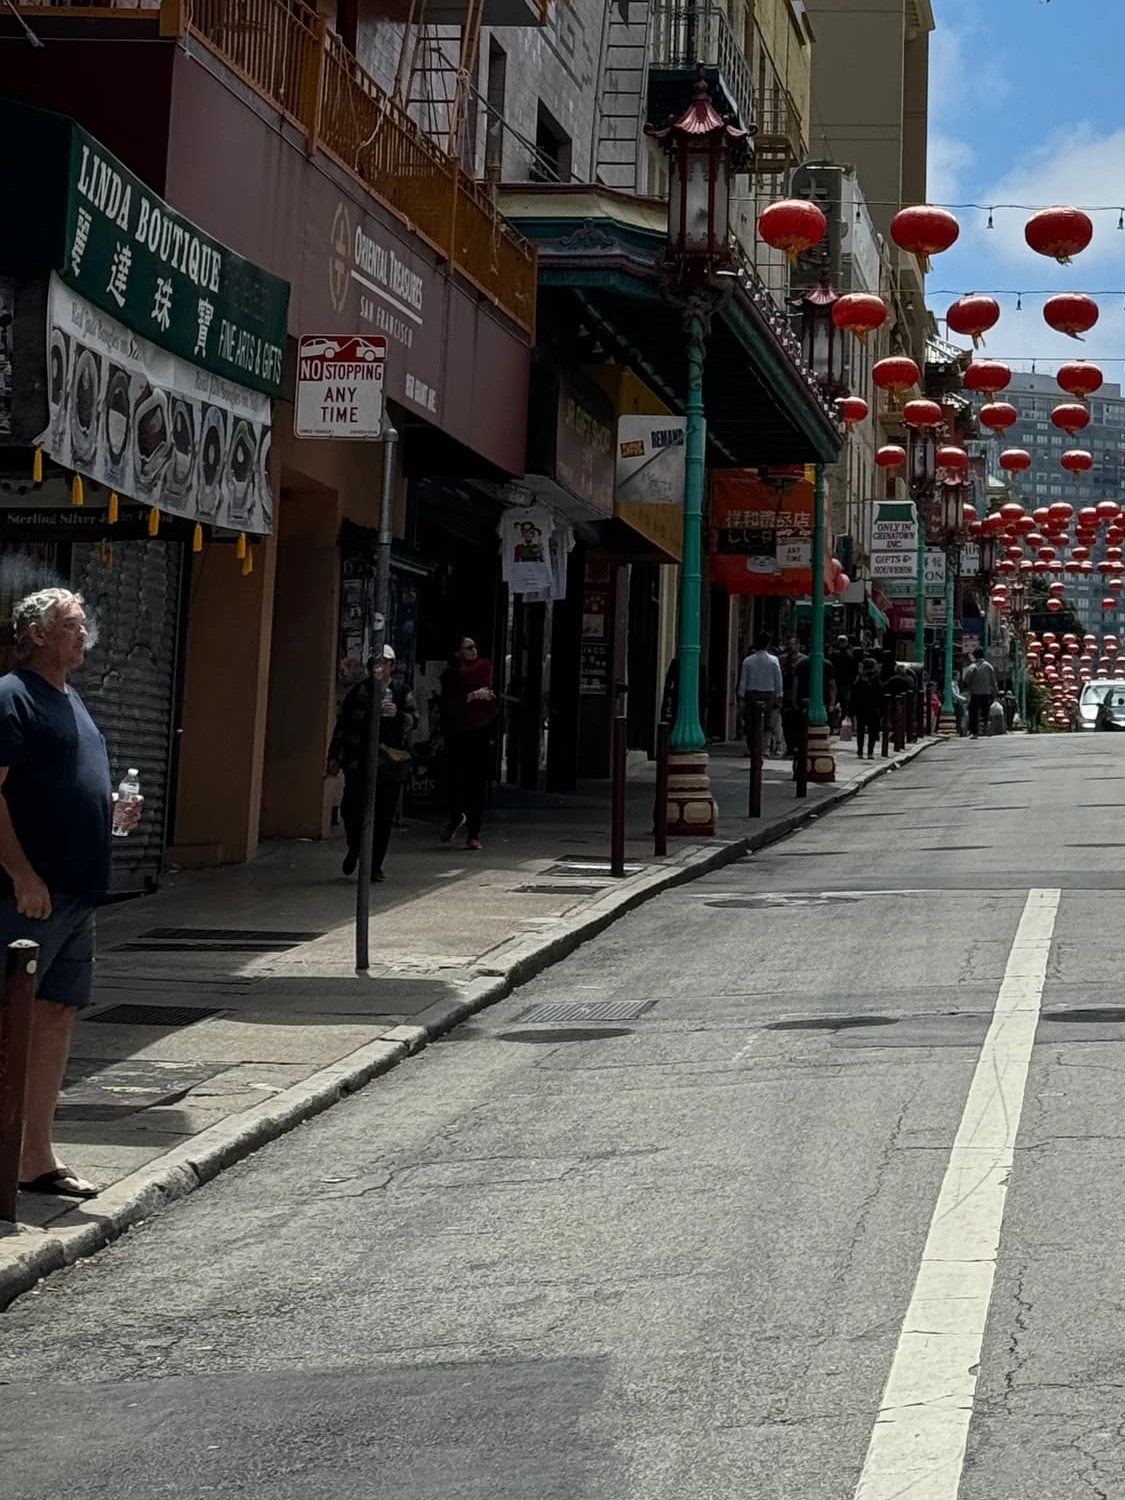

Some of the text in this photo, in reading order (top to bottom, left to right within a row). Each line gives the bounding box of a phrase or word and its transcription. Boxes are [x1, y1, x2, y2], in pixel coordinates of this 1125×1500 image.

[77, 144, 222, 294] LINDA BOUTIQUE
[360, 295, 373, 323] SAN
[235, 330, 254, 372] ARTS
[261, 341, 283, 384] GIFTS
[300, 359, 382, 380] NO STOPPING
[324, 387, 357, 402] ANY
[320, 407, 359, 423] TIME
[7, 512, 57, 525] Sterling
[59, 512, 96, 524] Silver
[875, 555, 901, 564] GIFTS
